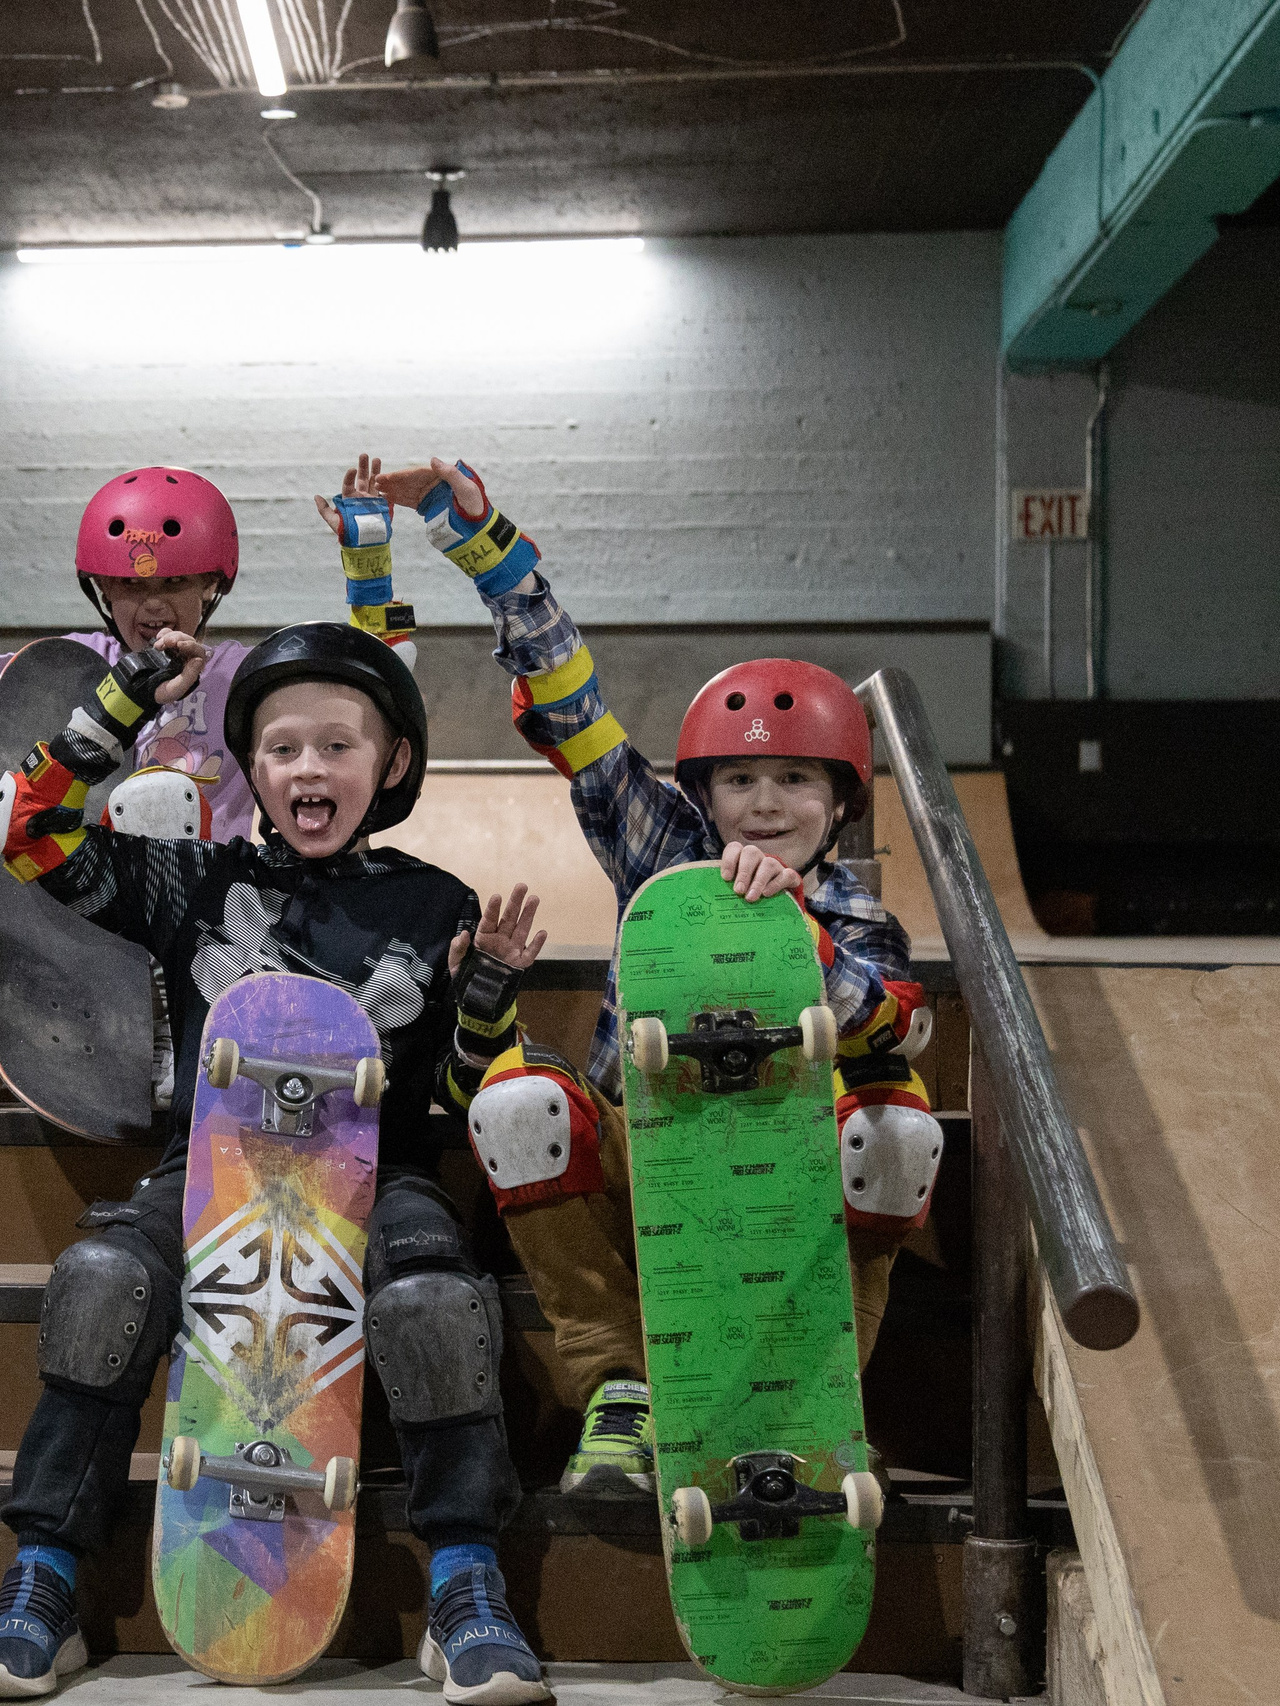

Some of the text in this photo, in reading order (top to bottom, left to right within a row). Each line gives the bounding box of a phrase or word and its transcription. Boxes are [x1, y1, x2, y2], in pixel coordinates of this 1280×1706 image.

[1023, 494, 1081, 538] EXIT
[123, 530, 164, 546] PARTY
[371, 568, 384, 577] YS
[716, 1224, 736, 1232] WON!
[389, 1236, 413, 1248] PRO
[726, 1332, 745, 1340] WON!
